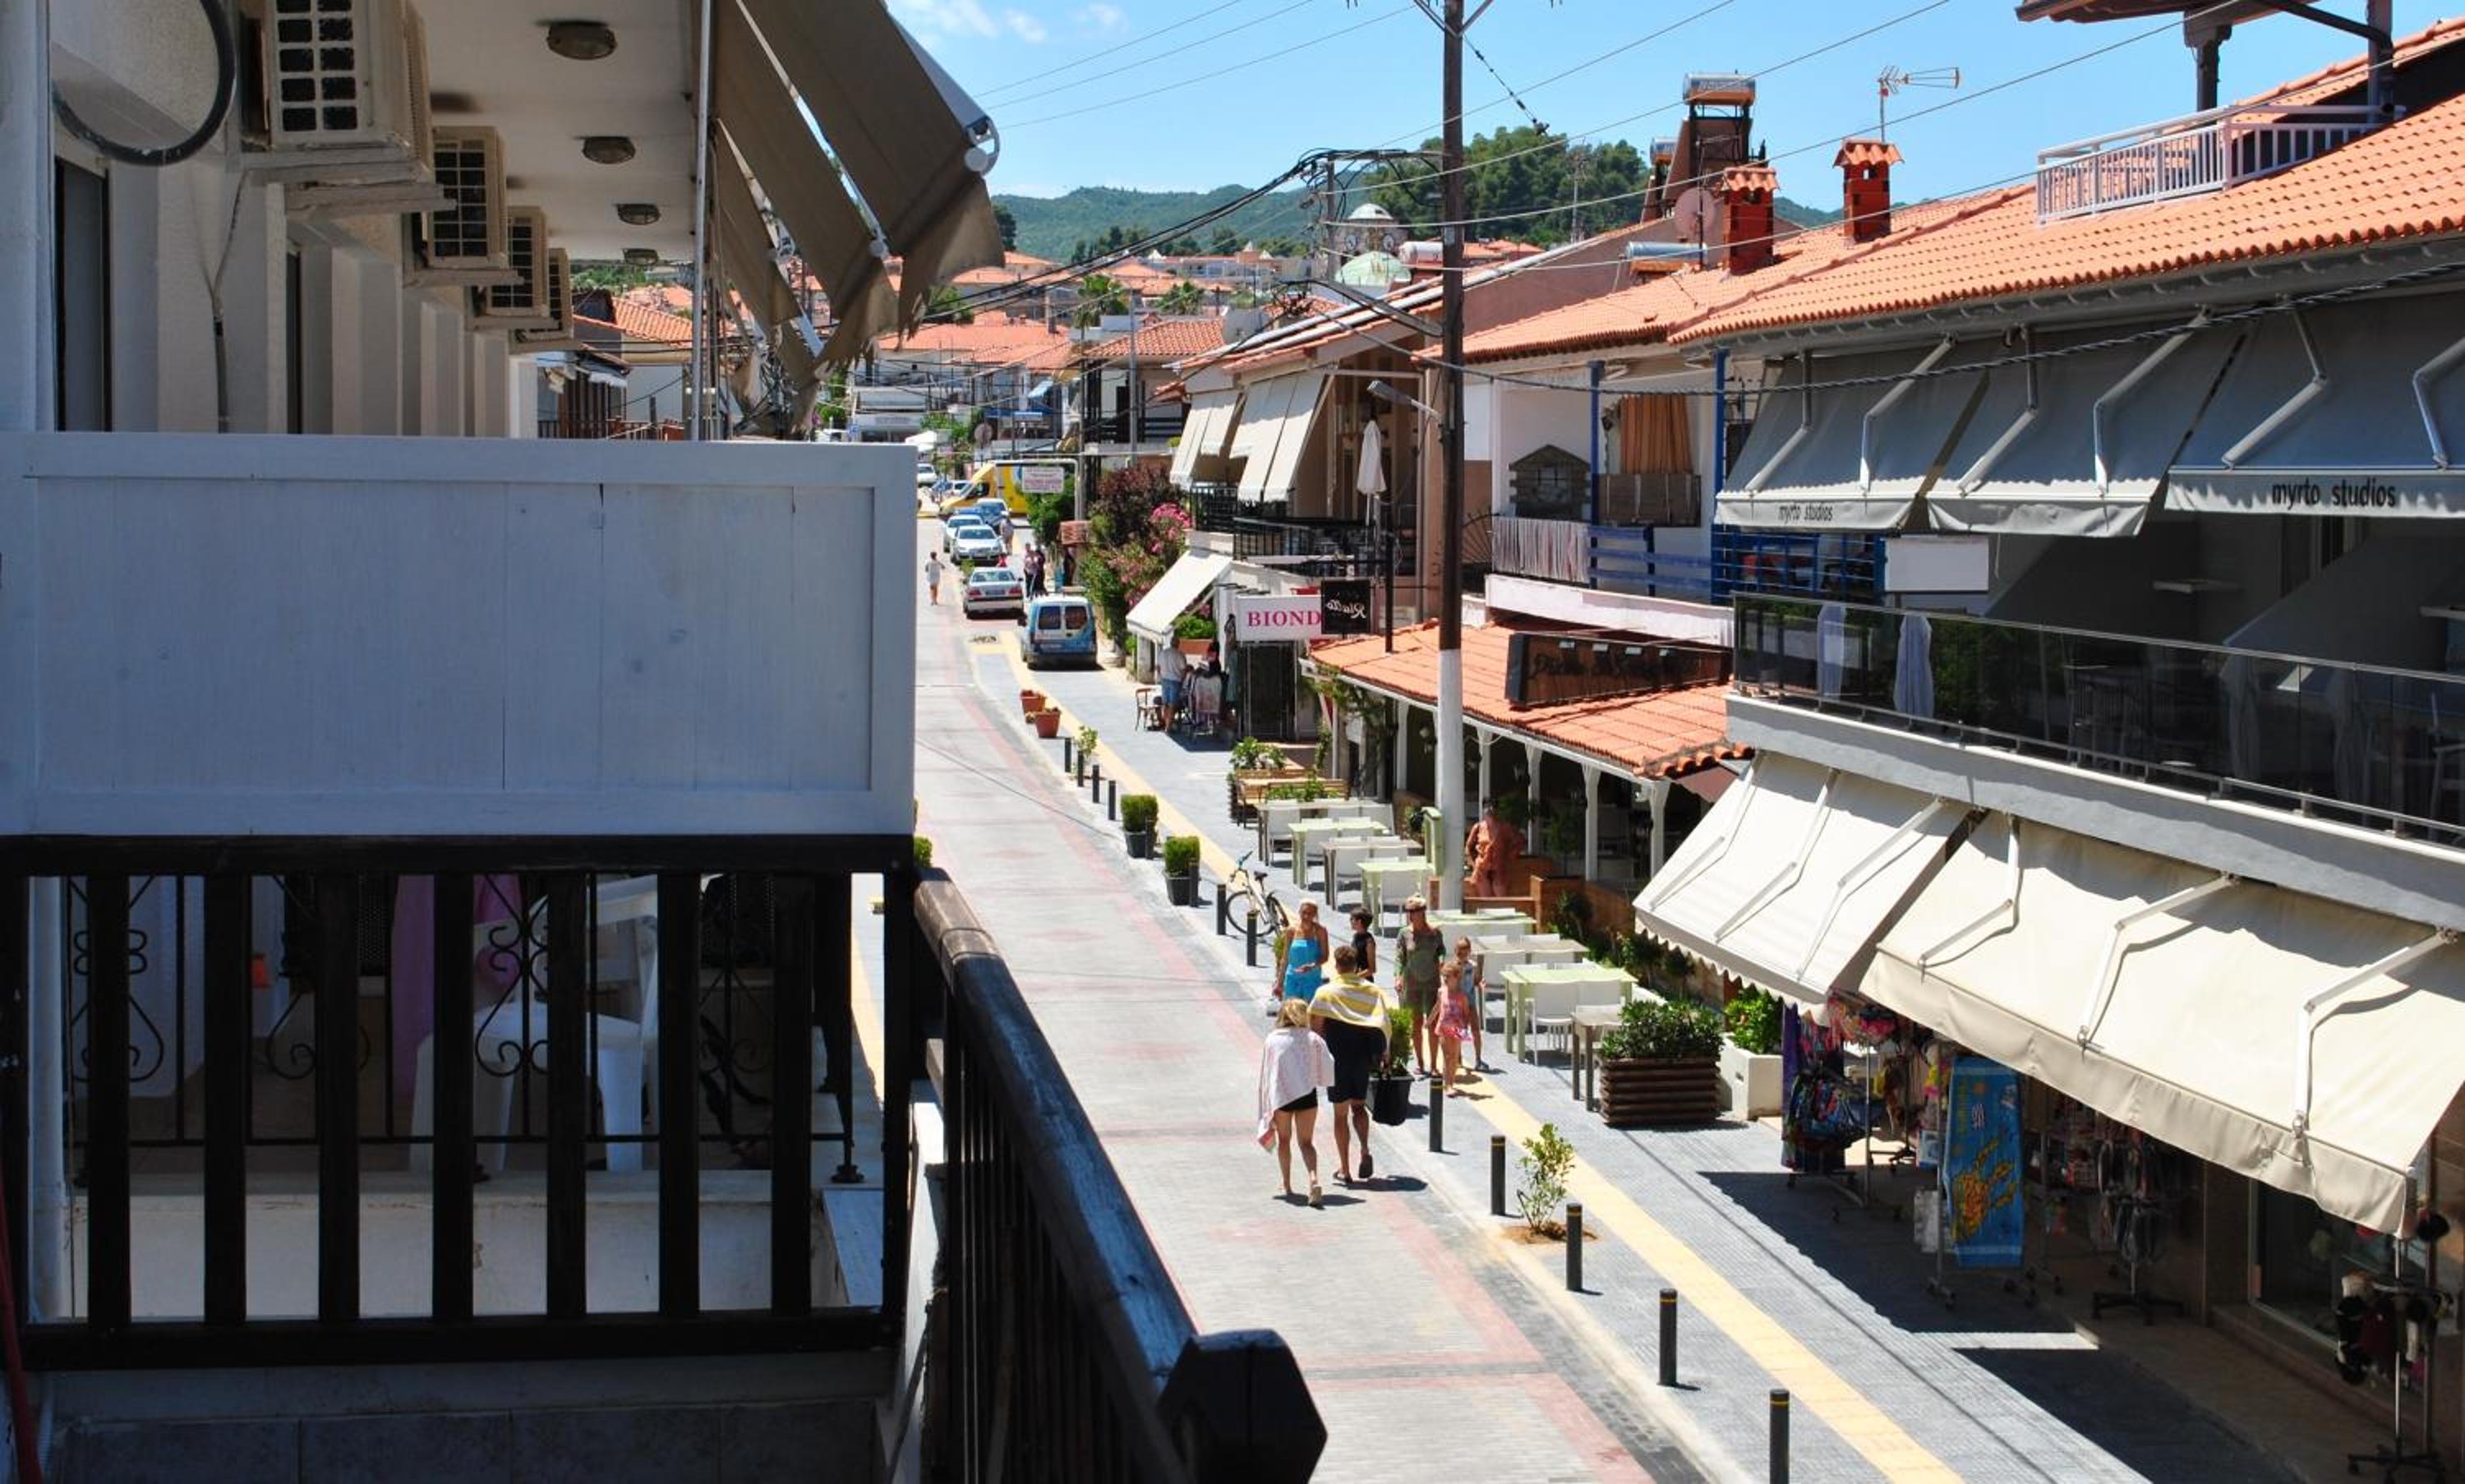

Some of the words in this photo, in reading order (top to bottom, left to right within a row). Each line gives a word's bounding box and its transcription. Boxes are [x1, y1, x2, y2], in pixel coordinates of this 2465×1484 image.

[2272, 477, 2320, 510] myrto
[2332, 477, 2396, 507] studios
[1778, 505, 1801, 524] myrto
[1804, 504, 1833, 522] studios
